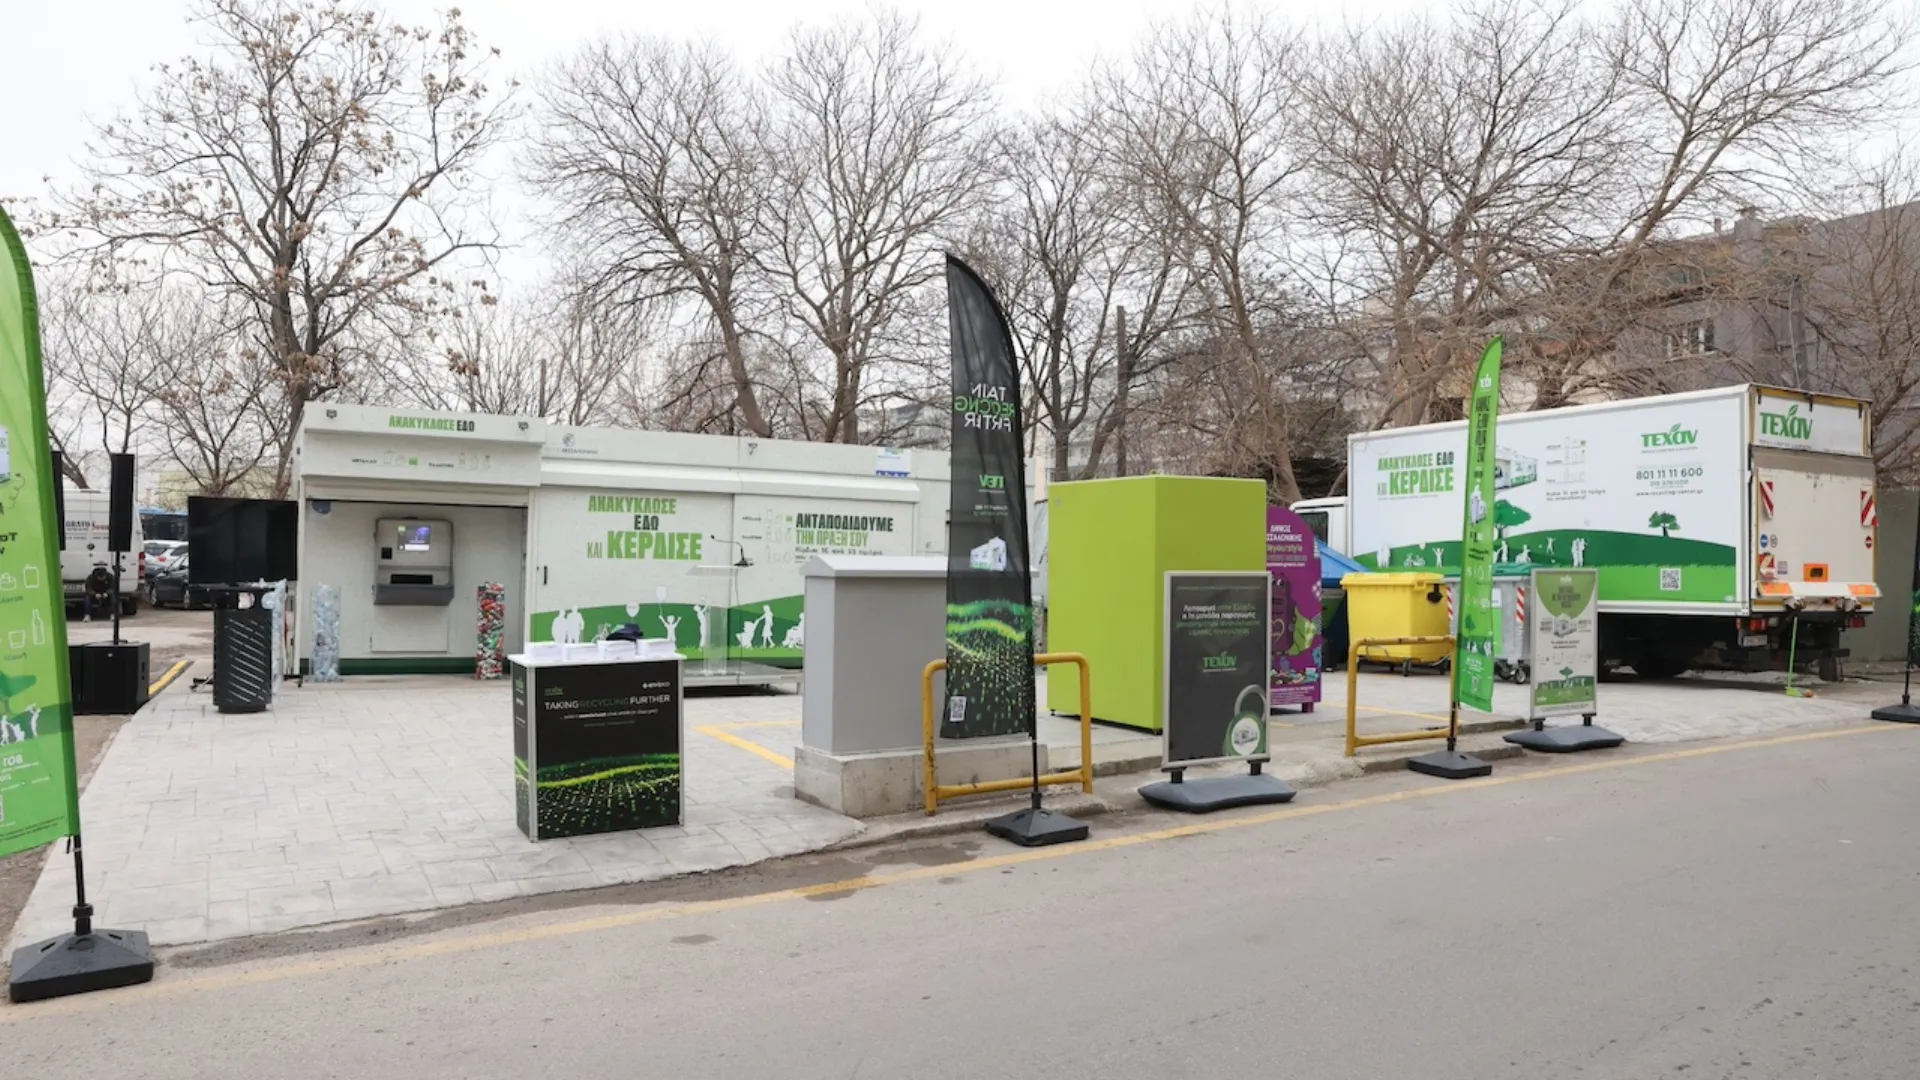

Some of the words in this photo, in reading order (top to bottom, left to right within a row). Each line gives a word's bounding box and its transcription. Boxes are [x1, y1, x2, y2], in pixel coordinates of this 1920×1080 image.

[388, 415, 455, 432] ΑΝΑΚΥΚΛΩΣΕ
[456, 420, 475, 432] ΕΔΩ
[1389, 467, 1454, 495] ΚΕΡΔΙΣΕ
[1636, 470, 1654, 480] 801
[1657, 469, 1666, 479] 11
[1669, 468, 1678, 478] 11
[1681, 467, 1704, 478] 600
[588, 495, 677, 514] ΑΝΑΚΥΚΛΩΣΕ
[634, 514, 659, 531] ΕΔΩ
[795, 512, 894, 532] ΑΝΤΑΠΟΔΙΔΟΥΜΕ
[587, 542, 603, 559] ΚΑΙ
[607, 530, 703, 560] ΚΕΡΔΙΣΕ
[796, 529, 814, 545] ΤΗΝ
[816, 530, 848, 546] ΠΡΑΞΗ
[849, 531, 869, 547] ΣΟΥ
[544, 700, 580, 711] TAKING
[580, 697, 629, 709] RECYCLING
[629, 694, 671, 706] FURTHER
